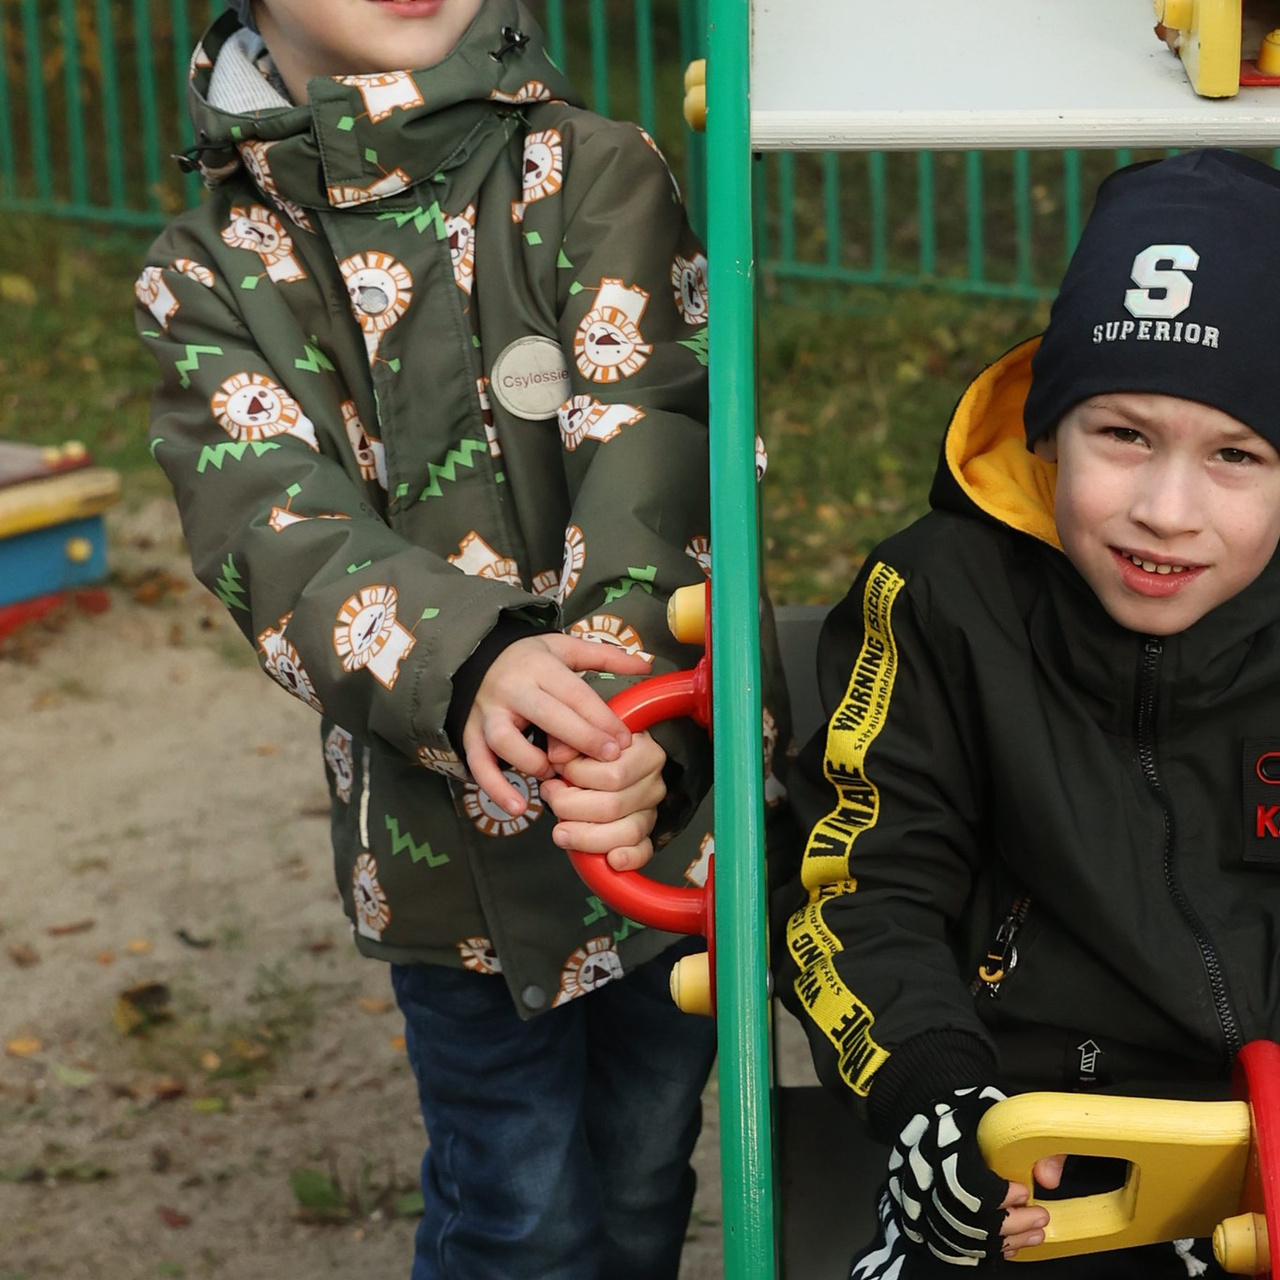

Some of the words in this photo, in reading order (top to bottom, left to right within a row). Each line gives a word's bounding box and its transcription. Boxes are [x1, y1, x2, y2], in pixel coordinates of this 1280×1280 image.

[1123, 244, 1200, 319] S
[1092, 321, 1220, 349] SUPERIOR
[832, 636, 884, 732] WARNING
